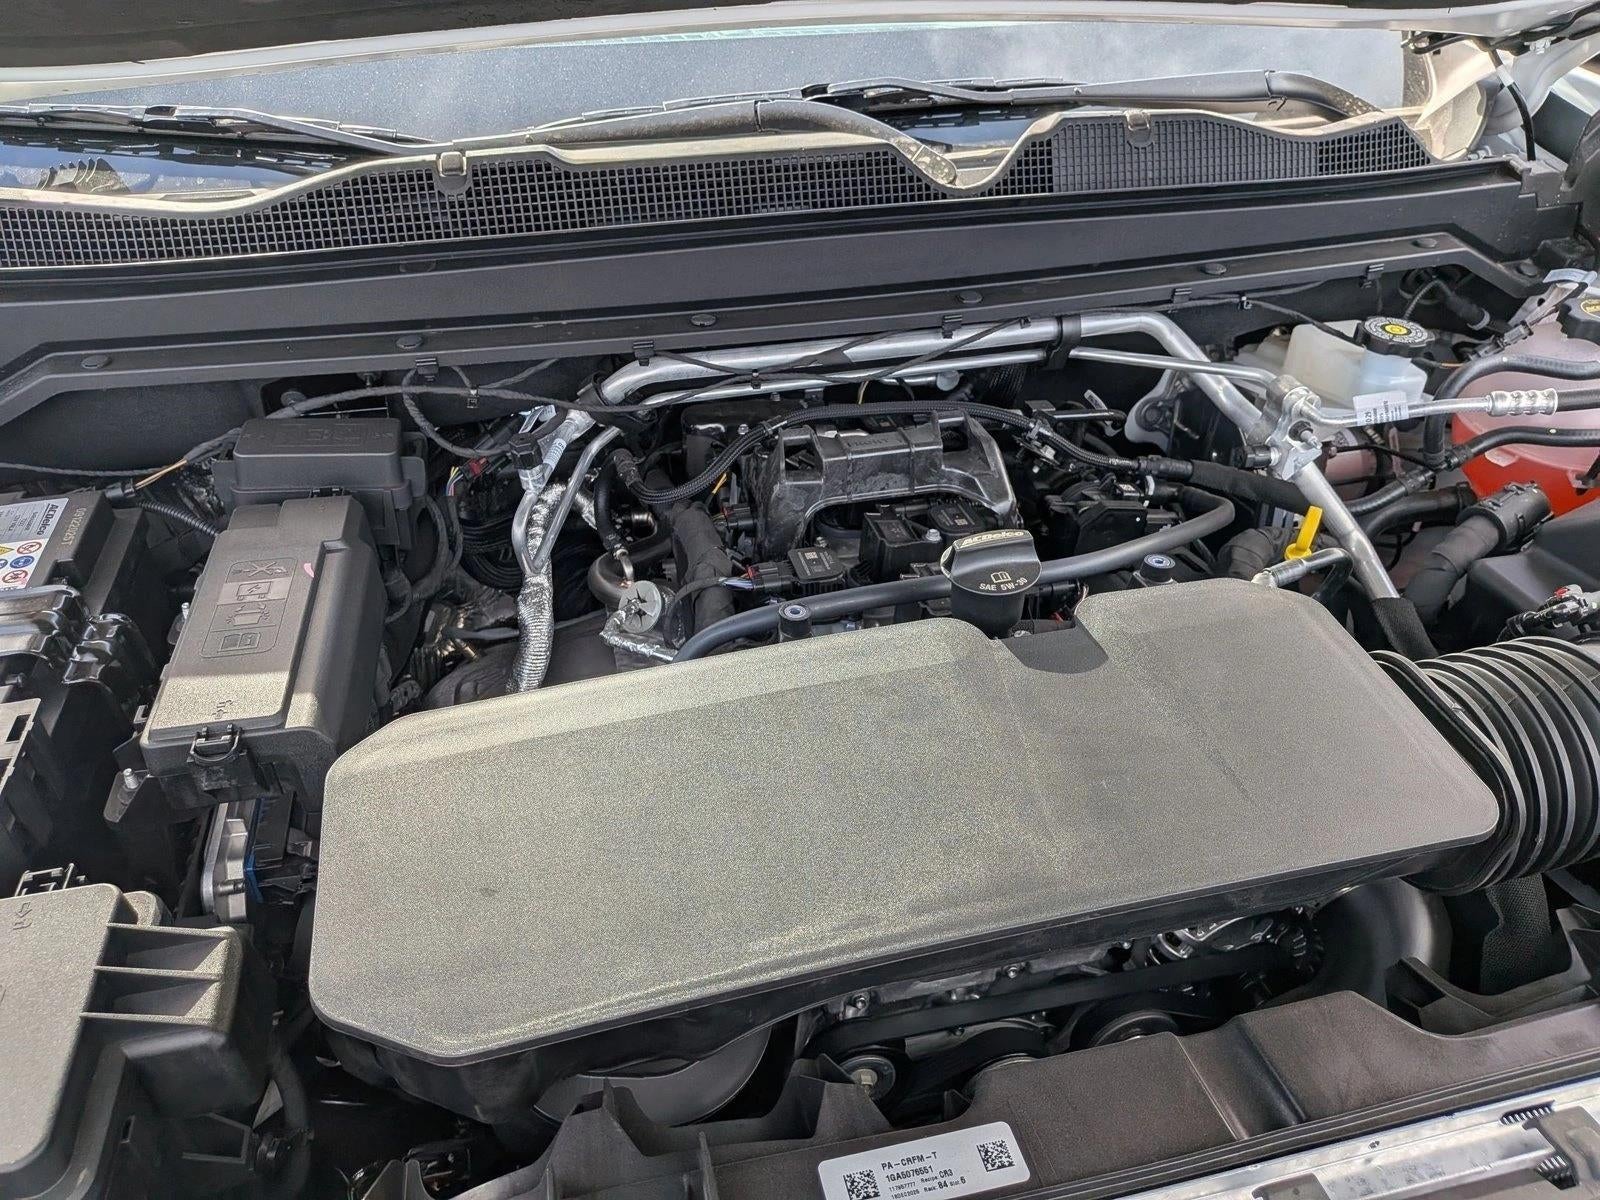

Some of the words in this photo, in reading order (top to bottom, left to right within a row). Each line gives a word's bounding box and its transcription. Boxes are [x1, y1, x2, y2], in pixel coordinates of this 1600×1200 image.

[979, 583, 997, 591] SAE
[1001, 577, 1028, 591] 5W-30
[881, 1151, 938, 1171] PA-CRFM-T
[939, 1169, 953, 1181] CR3
[938, 1180, 948, 1190] 84
